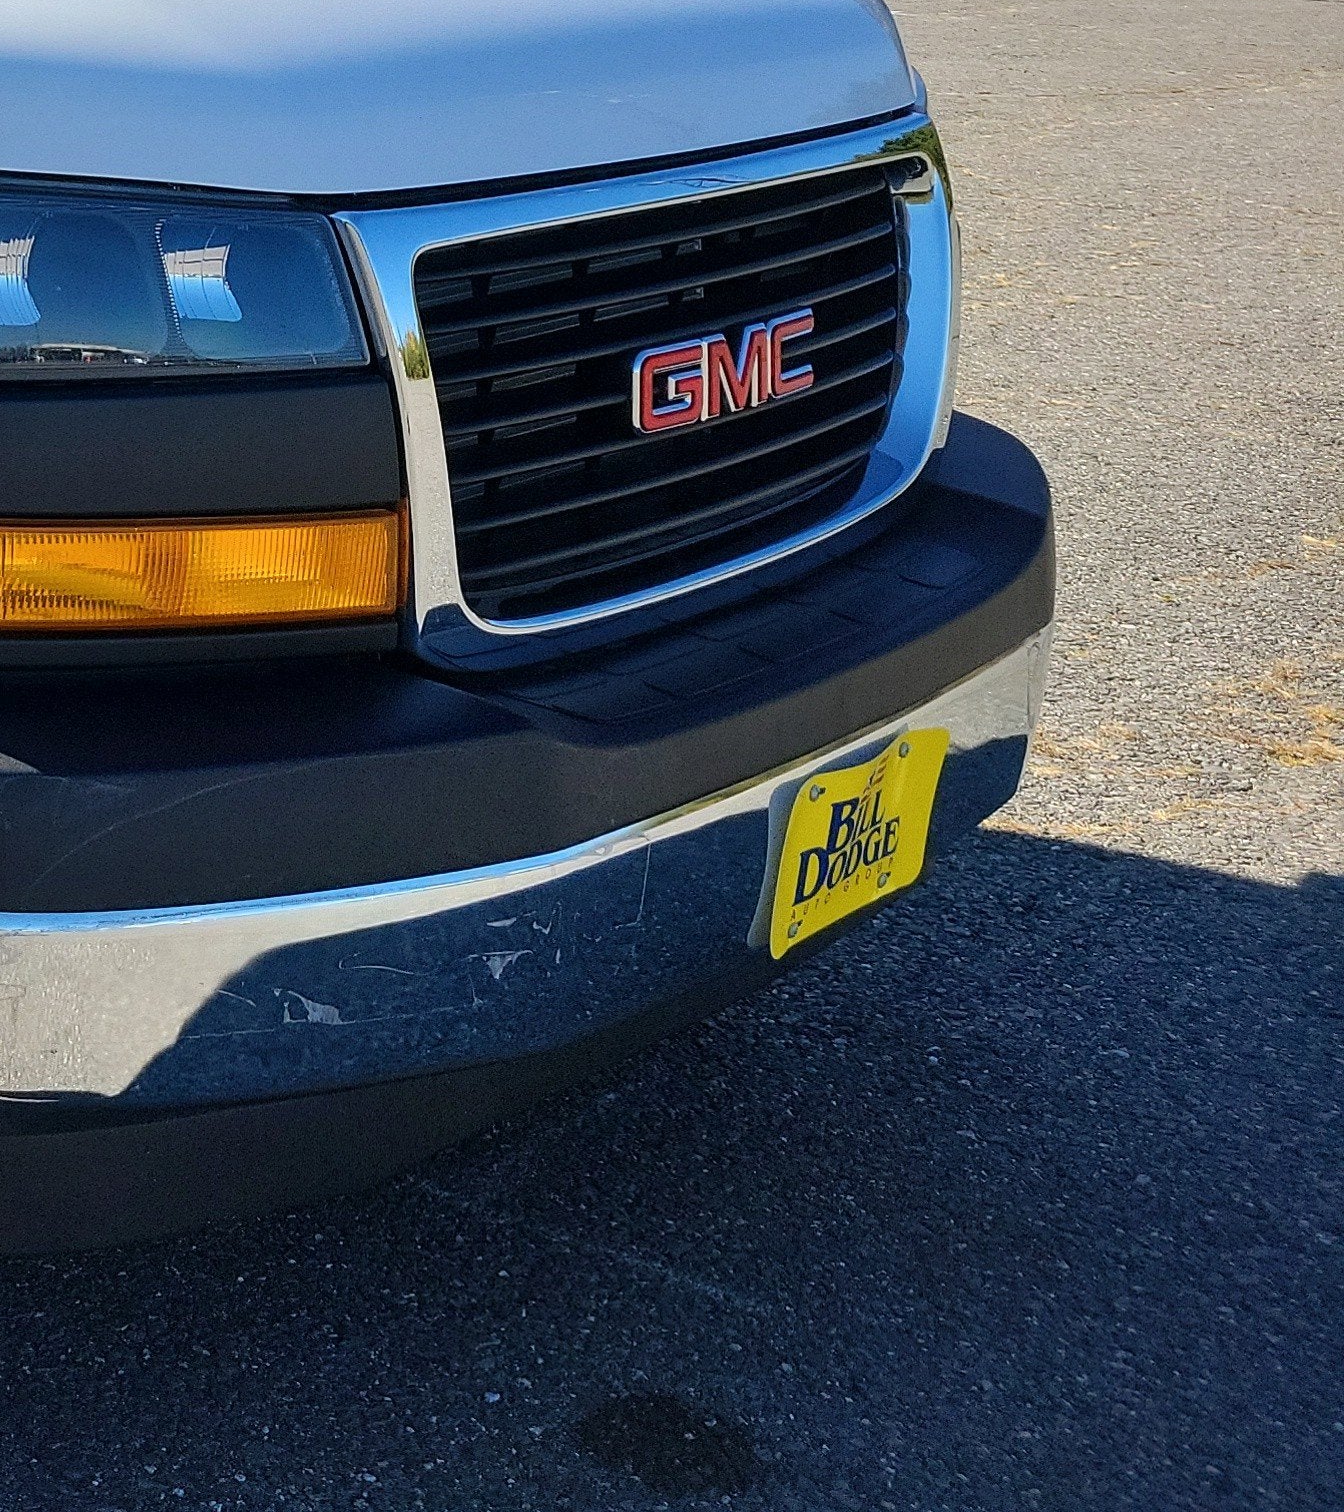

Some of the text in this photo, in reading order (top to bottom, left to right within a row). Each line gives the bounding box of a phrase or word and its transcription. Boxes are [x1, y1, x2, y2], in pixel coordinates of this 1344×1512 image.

[633, 308, 814, 434] GMC
[792, 815, 900, 906] DODGE
[827, 788, 885, 854] BILL
